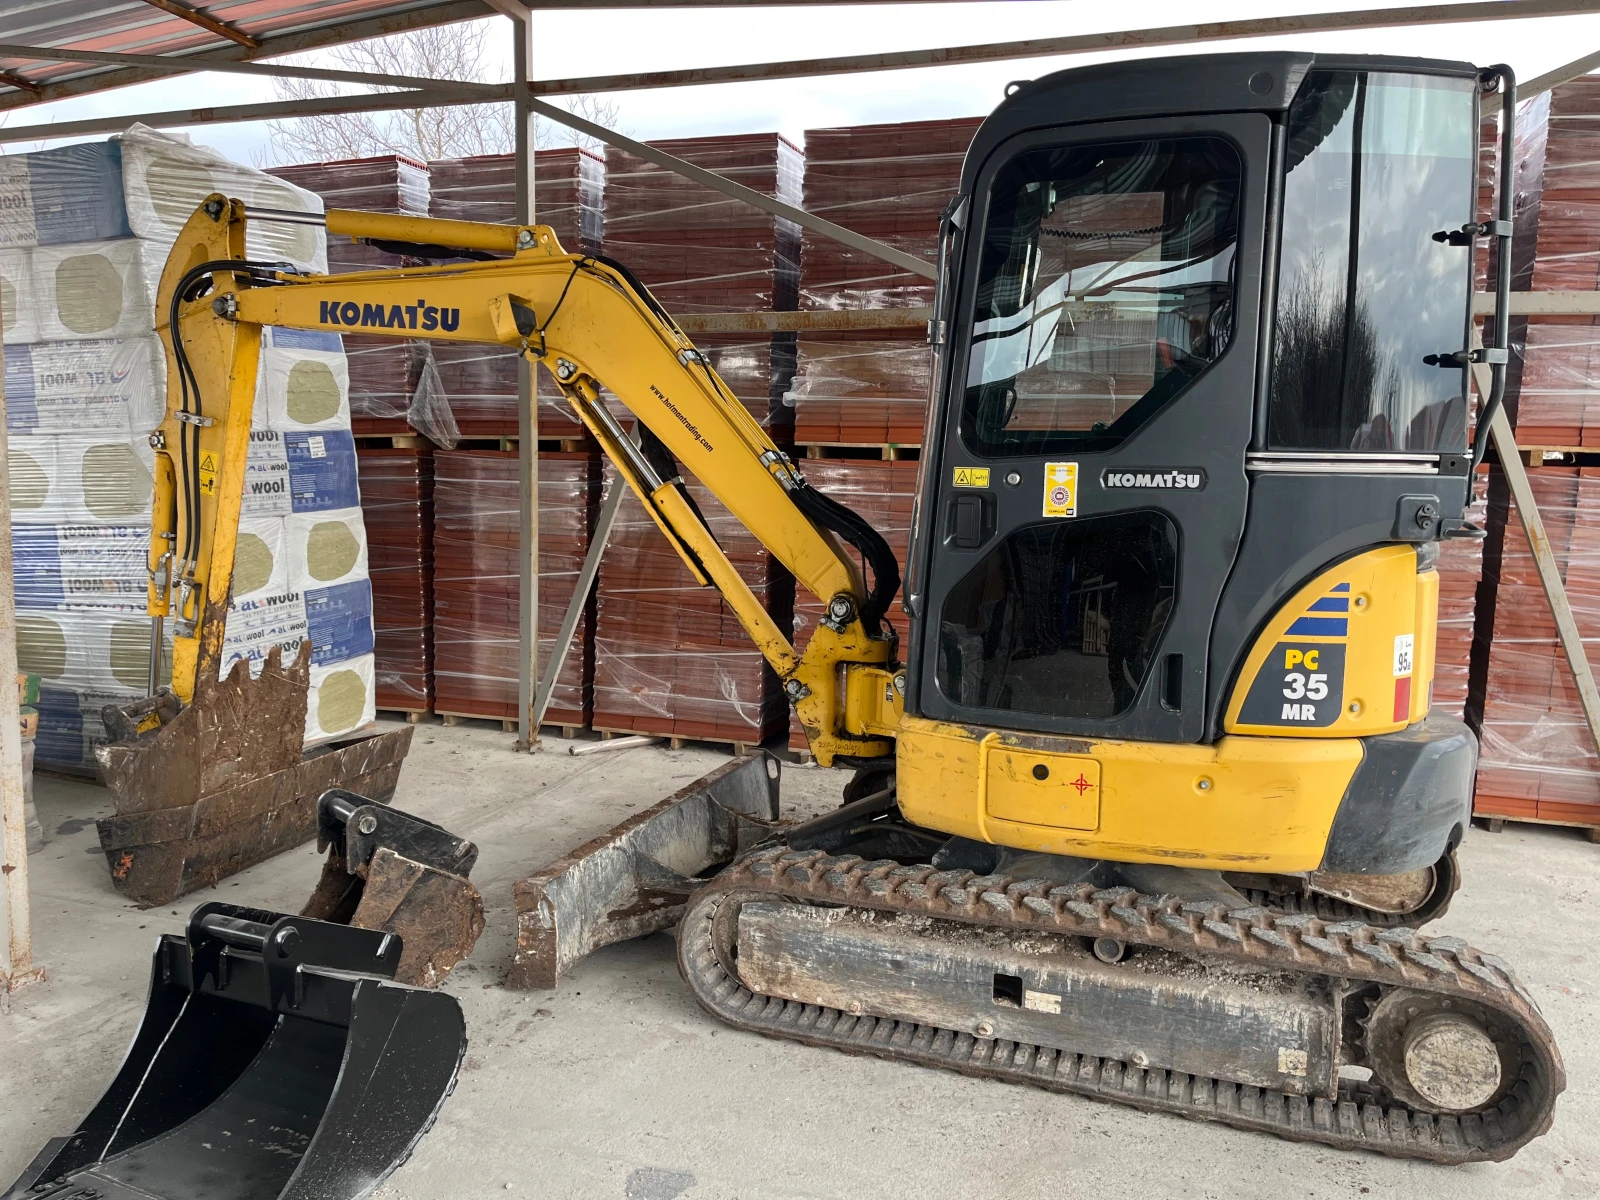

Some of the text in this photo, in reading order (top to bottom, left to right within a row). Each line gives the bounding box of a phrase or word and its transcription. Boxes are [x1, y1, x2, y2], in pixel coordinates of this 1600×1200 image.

[319, 299, 460, 332] KOMATSU
[649, 384, 714, 453] www.hofmantrading.com
[1107, 470, 1200, 489] KOMATSU
[1285, 649, 1320, 671] PC
[1398, 652, 1408, 672] 95
[1282, 672, 1329, 701] 35
[1281, 703, 1316, 721] MR
